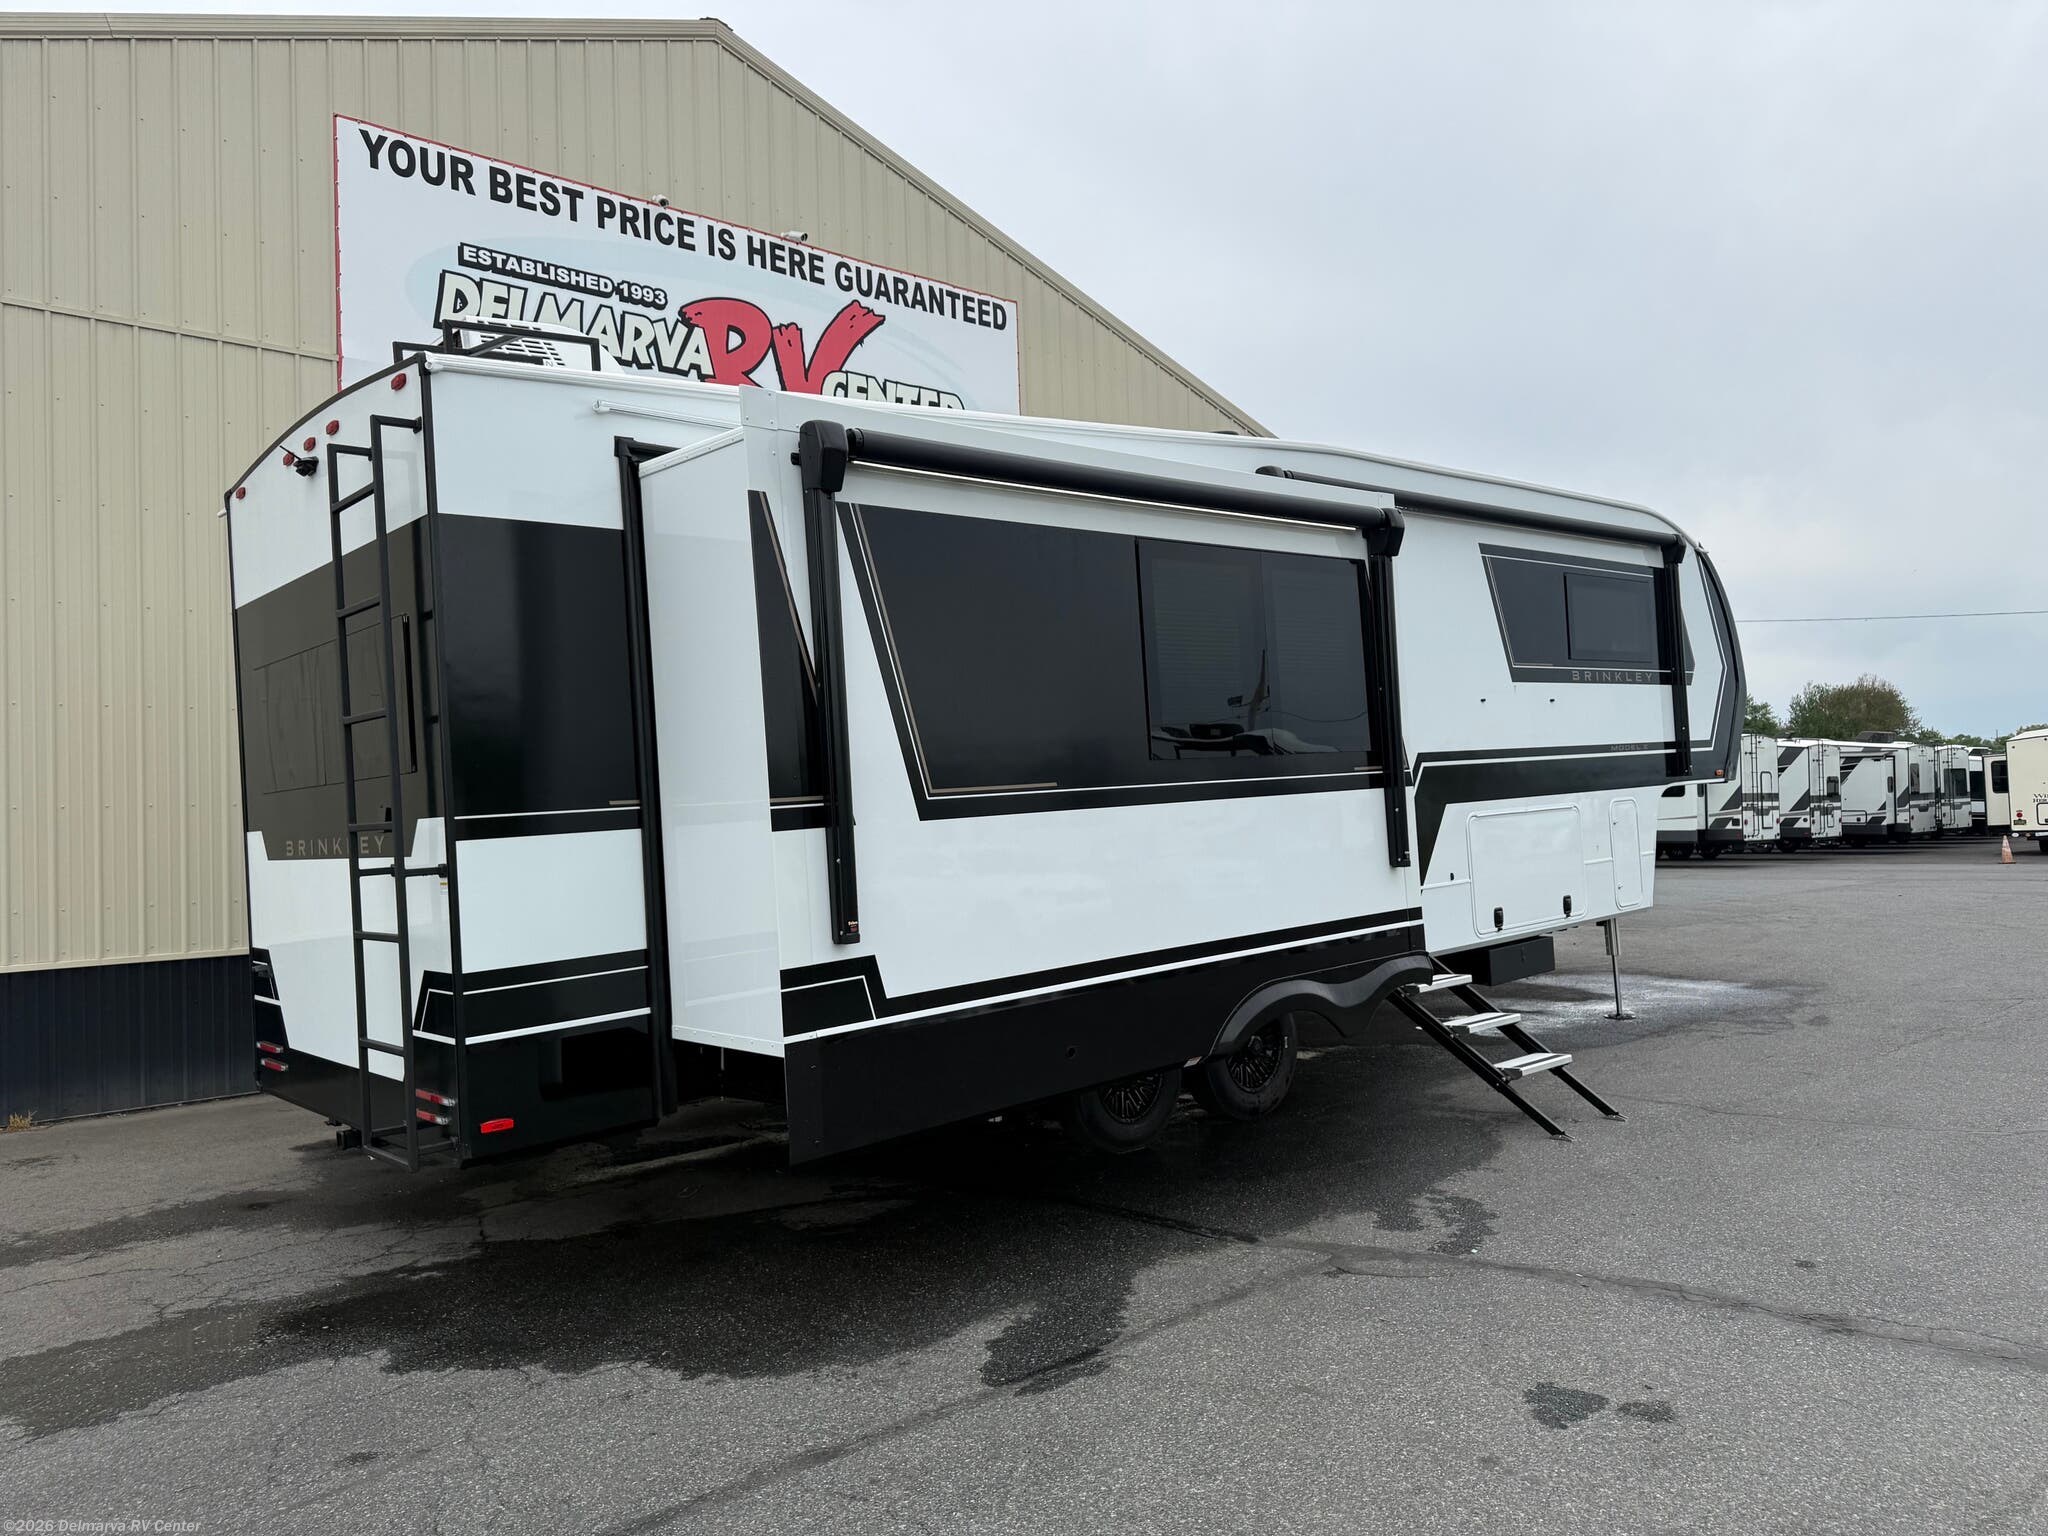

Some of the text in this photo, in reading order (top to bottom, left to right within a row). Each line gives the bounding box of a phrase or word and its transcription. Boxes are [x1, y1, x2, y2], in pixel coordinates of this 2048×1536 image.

[358, 129, 1008, 331] YOUR BEST PRICE IS HERE GUARANTEED
[461, 244, 667, 307] ESTABLISHED 1993
[678, 297, 886, 394] RV
[1571, 670, 1652, 682] BRINKLEY
